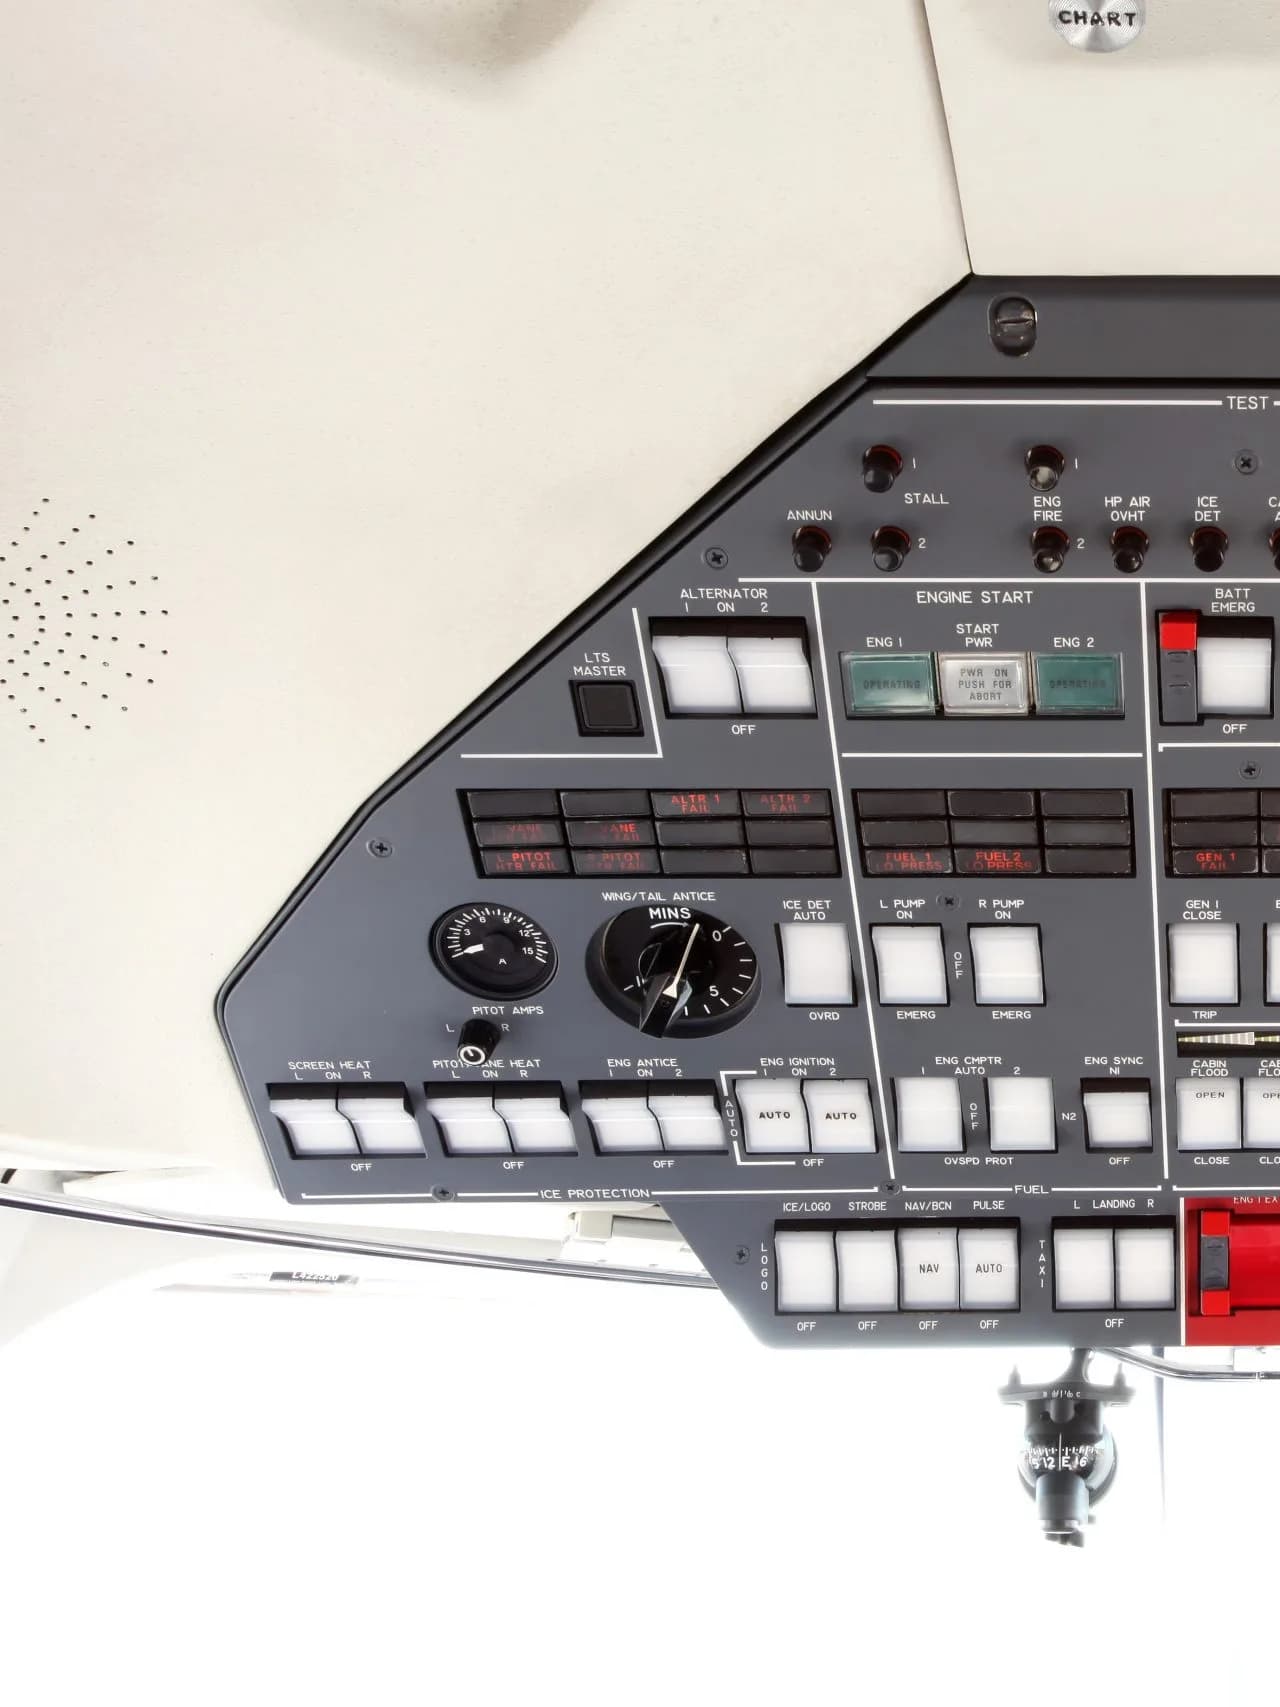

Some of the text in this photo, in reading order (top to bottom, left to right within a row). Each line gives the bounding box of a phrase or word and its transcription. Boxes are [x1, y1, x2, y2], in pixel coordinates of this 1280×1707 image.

[1057, 9, 1137, 28] CHART
[1226, 395, 1270, 410] TEST
[903, 492, 950, 505] STALL
[1033, 495, 1062, 508] ENG
[1104, 495, 1151, 508] HP AIR
[1197, 495, 1219, 508] ICE
[786, 509, 833, 521] ANNUN
[1033, 509, 1063, 522] FIRE
[1110, 509, 1146, 522] OVHT
[1194, 510, 1222, 522] DET
[680, 587, 768, 600] ALTERNATOR
[916, 590, 1034, 604] ENGINE START
[1215, 587, 1252, 600] BATT
[716, 601, 736, 613] ON
[1211, 601, 1256, 613] EMERG
[955, 623, 1000, 635] START
[866, 636, 893, 648] ENG
[964, 636, 993, 648] PWR
[1053, 636, 1081, 649] ENG
[584, 651, 611, 664] LTS
[572, 665, 627, 677] MASTER
[957, 679, 1013, 690] PUSH FOR
[968, 691, 1003, 702] ABORT
[1222, 723, 1248, 735] OFF
[884, 851, 917, 862] FUEL
[974, 851, 1010, 862] FUEL
[1195, 852, 1223, 862] GEN
[601, 891, 717, 902] WING/TAIL ANTICE
[782, 899, 832, 910] ICE DET
[893, 898, 926, 909] PUMP
[1185, 899, 1210, 910] GEN
[648, 906, 692, 920] MINS
[793, 910, 826, 921] AUTO
[1182, 910, 1222, 921] CLOSE
[471, 1005, 545, 1015] PITOT AMPS
[808, 1011, 840, 1021] OVRD
[1191, 1010, 1218, 1020] TRIP
[287, 1060, 371, 1071] SCREEN HEAT
[606, 1057, 679, 1068] ENG ANTICE
[759, 1056, 836, 1067] ENG IGNITION
[963, 1055, 1002, 1065] CMPTR
[1112, 1056, 1144, 1066] SYNC
[1192, 1059, 1228, 1069] CABIN
[954, 1065, 986, 1076] AUTO
[1190, 1067, 1229, 1077] FLOOD
[1195, 1091, 1226, 1100] OPEN
[762, 1110, 789, 1120] AUTO
[350, 1162, 373, 1172] OFF
[943, 1156, 1015, 1166] OVSPD PROT
[567, 1188, 651, 1199] PROTECTION
[782, 1201, 832, 1213] ICE/LOGO
[848, 1200, 888, 1212] STROBE
[904, 1200, 952, 1212] NAV/BCN
[972, 1199, 1006, 1211] PULSE
[1092, 1198, 1136, 1210] LANDING
[918, 1263, 939, 1274] NAV
[1104, 1317, 1125, 1329] OFF
